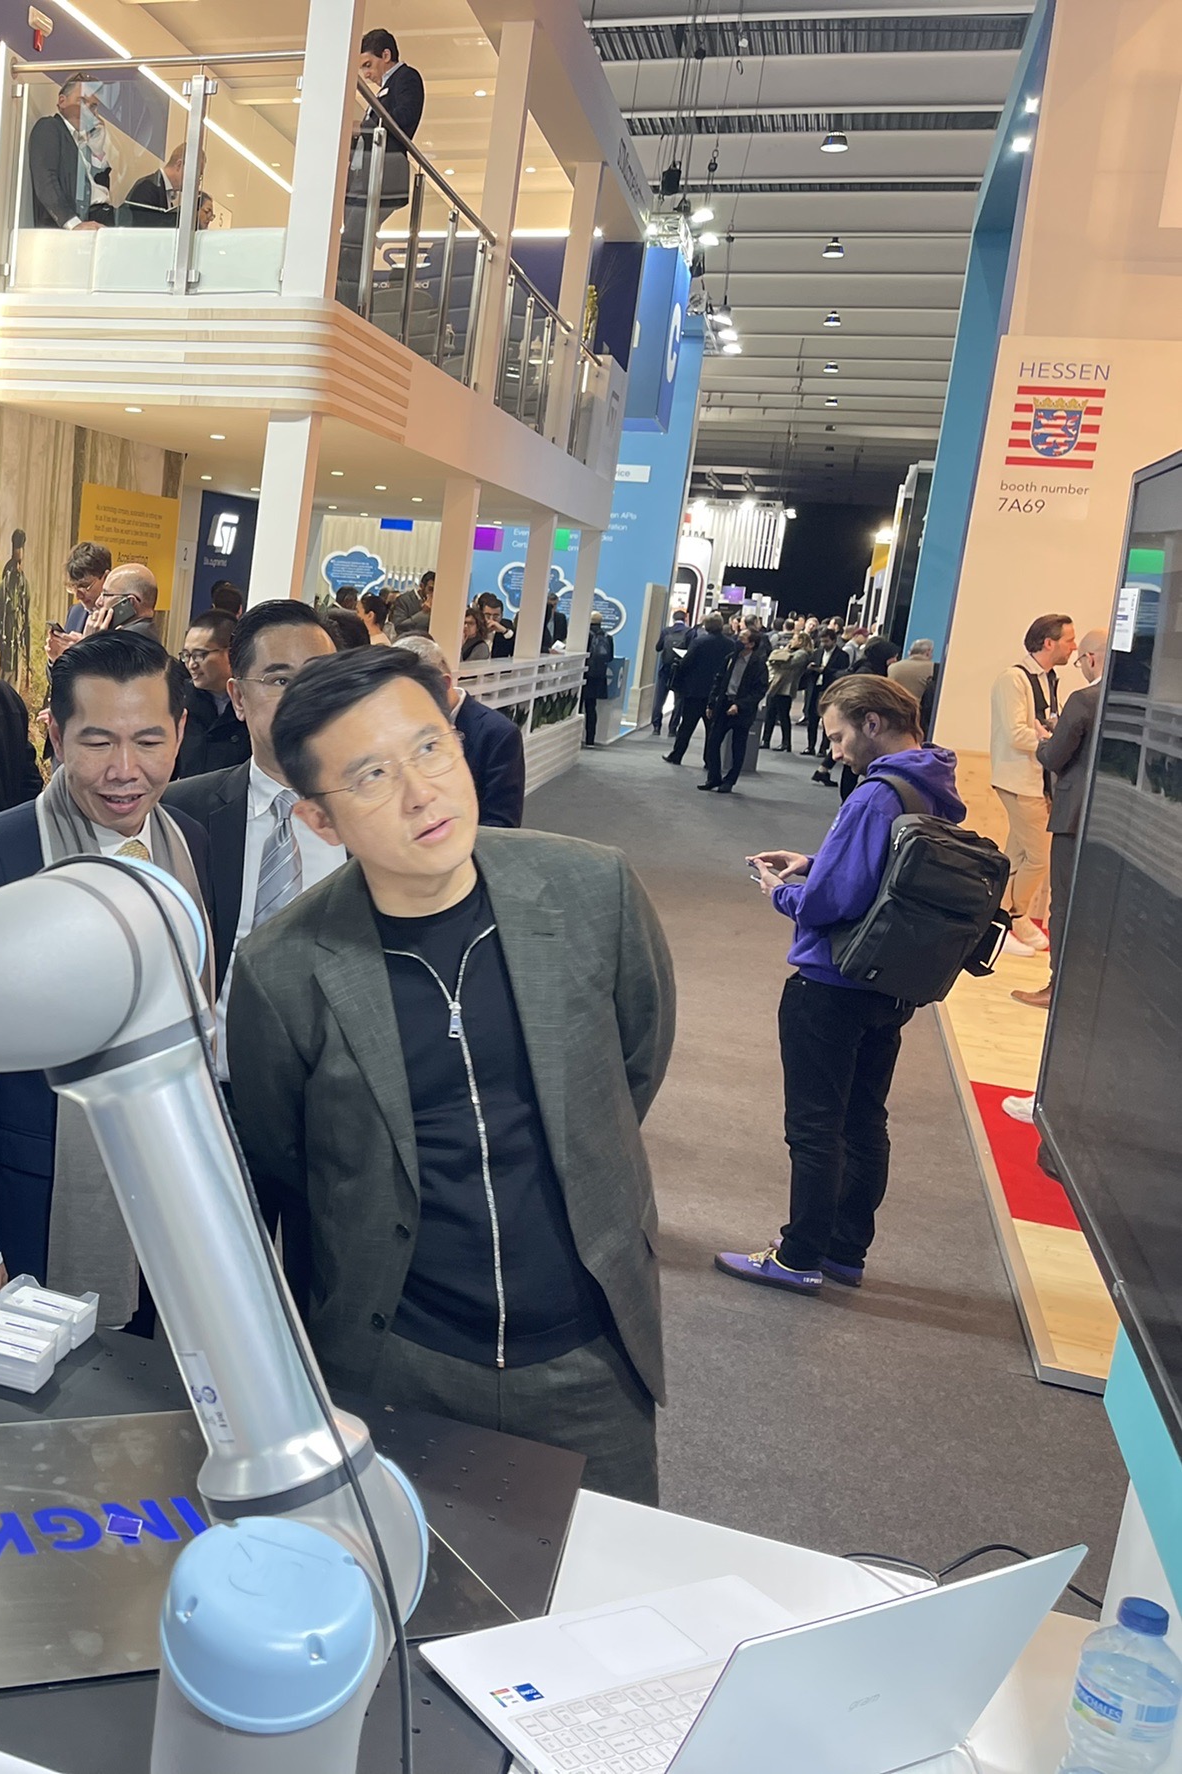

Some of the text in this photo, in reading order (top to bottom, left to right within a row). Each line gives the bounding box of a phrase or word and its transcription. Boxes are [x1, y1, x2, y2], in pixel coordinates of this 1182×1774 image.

[1019, 361, 1111, 381] HESSEN
[1000, 479, 1090, 496] booth number
[998, 497, 1046, 514] 7A69
